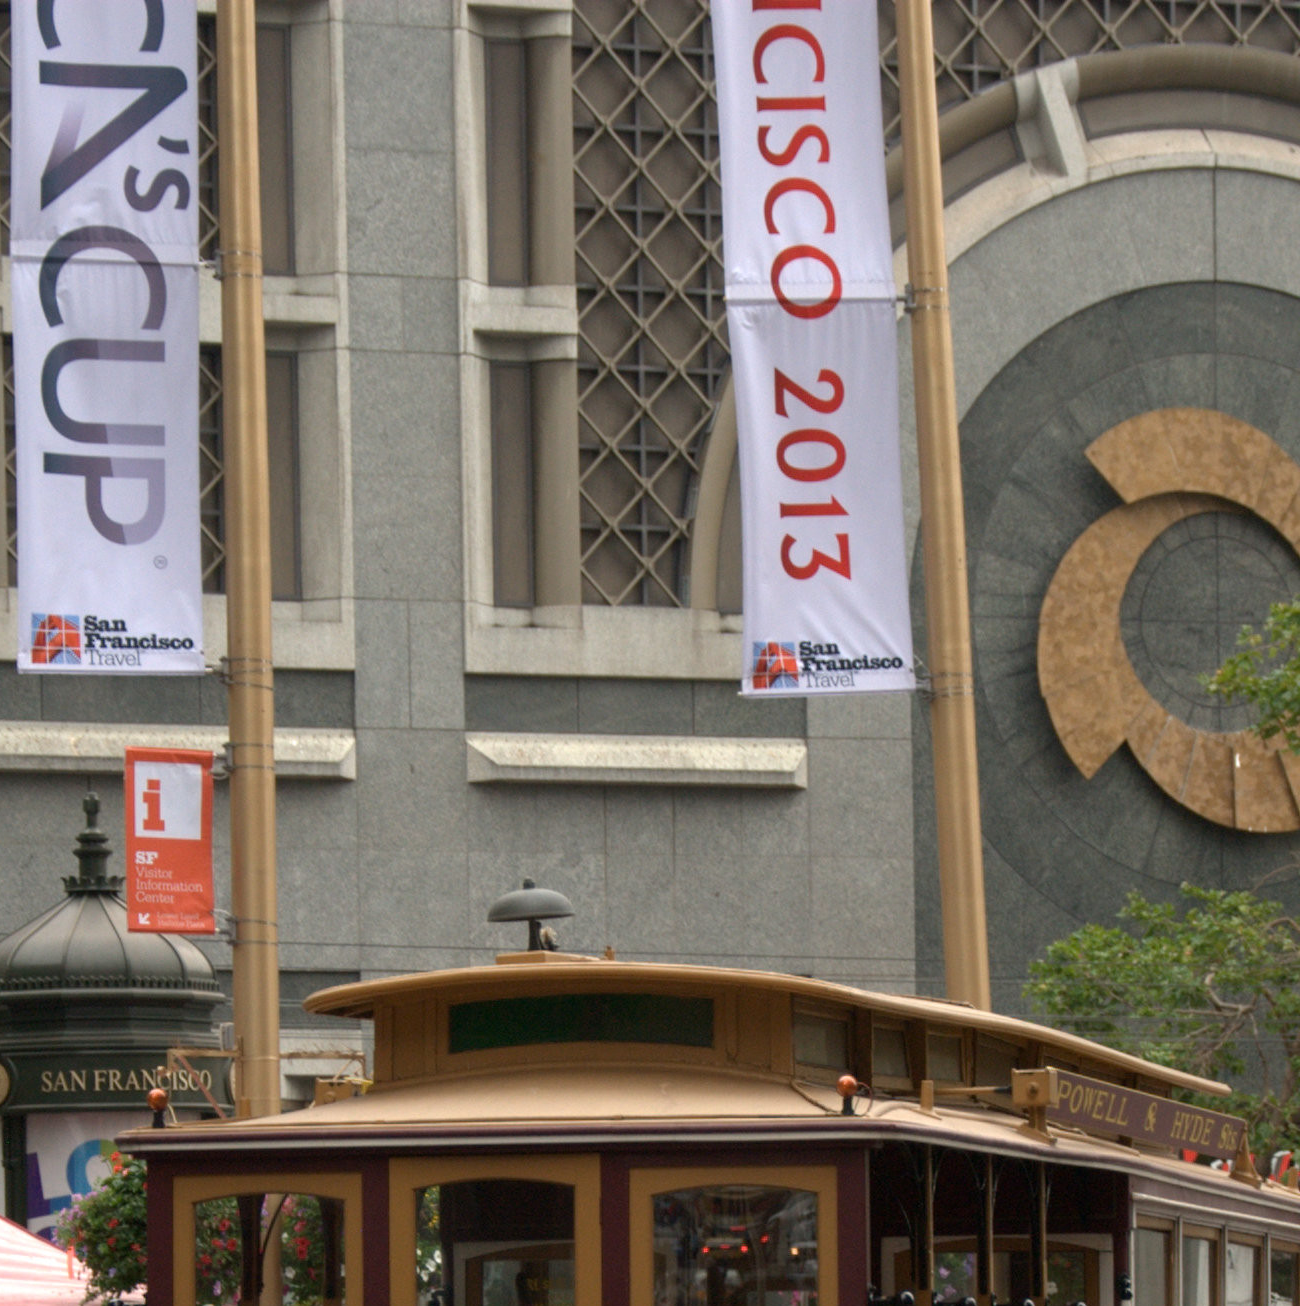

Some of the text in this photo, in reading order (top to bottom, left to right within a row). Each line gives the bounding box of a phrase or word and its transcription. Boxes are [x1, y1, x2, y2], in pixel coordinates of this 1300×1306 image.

[752, 0, 852, 581] CISCO 2013
[39, 225, 167, 545] CUP
[83, 615, 127, 632] San
[84, 633, 194, 650] Francisco
[799, 641, 840, 656] San
[84, 651, 142, 666] Travel
[800, 655, 904, 671] Francisco
[801, 671, 856, 688] Travel
[135, 851, 158, 865] SF
[135, 866, 174, 880] Visitor
[136, 879, 204, 893] Information
[135, 891, 175, 905] Center
[41, 1068, 212, 1093] SAN FRANCISCO
[1057, 1080, 1128, 1126] POWELL
[1144, 1103, 1158, 1132] &
[1170, 1110, 1216, 1146] HYDE
